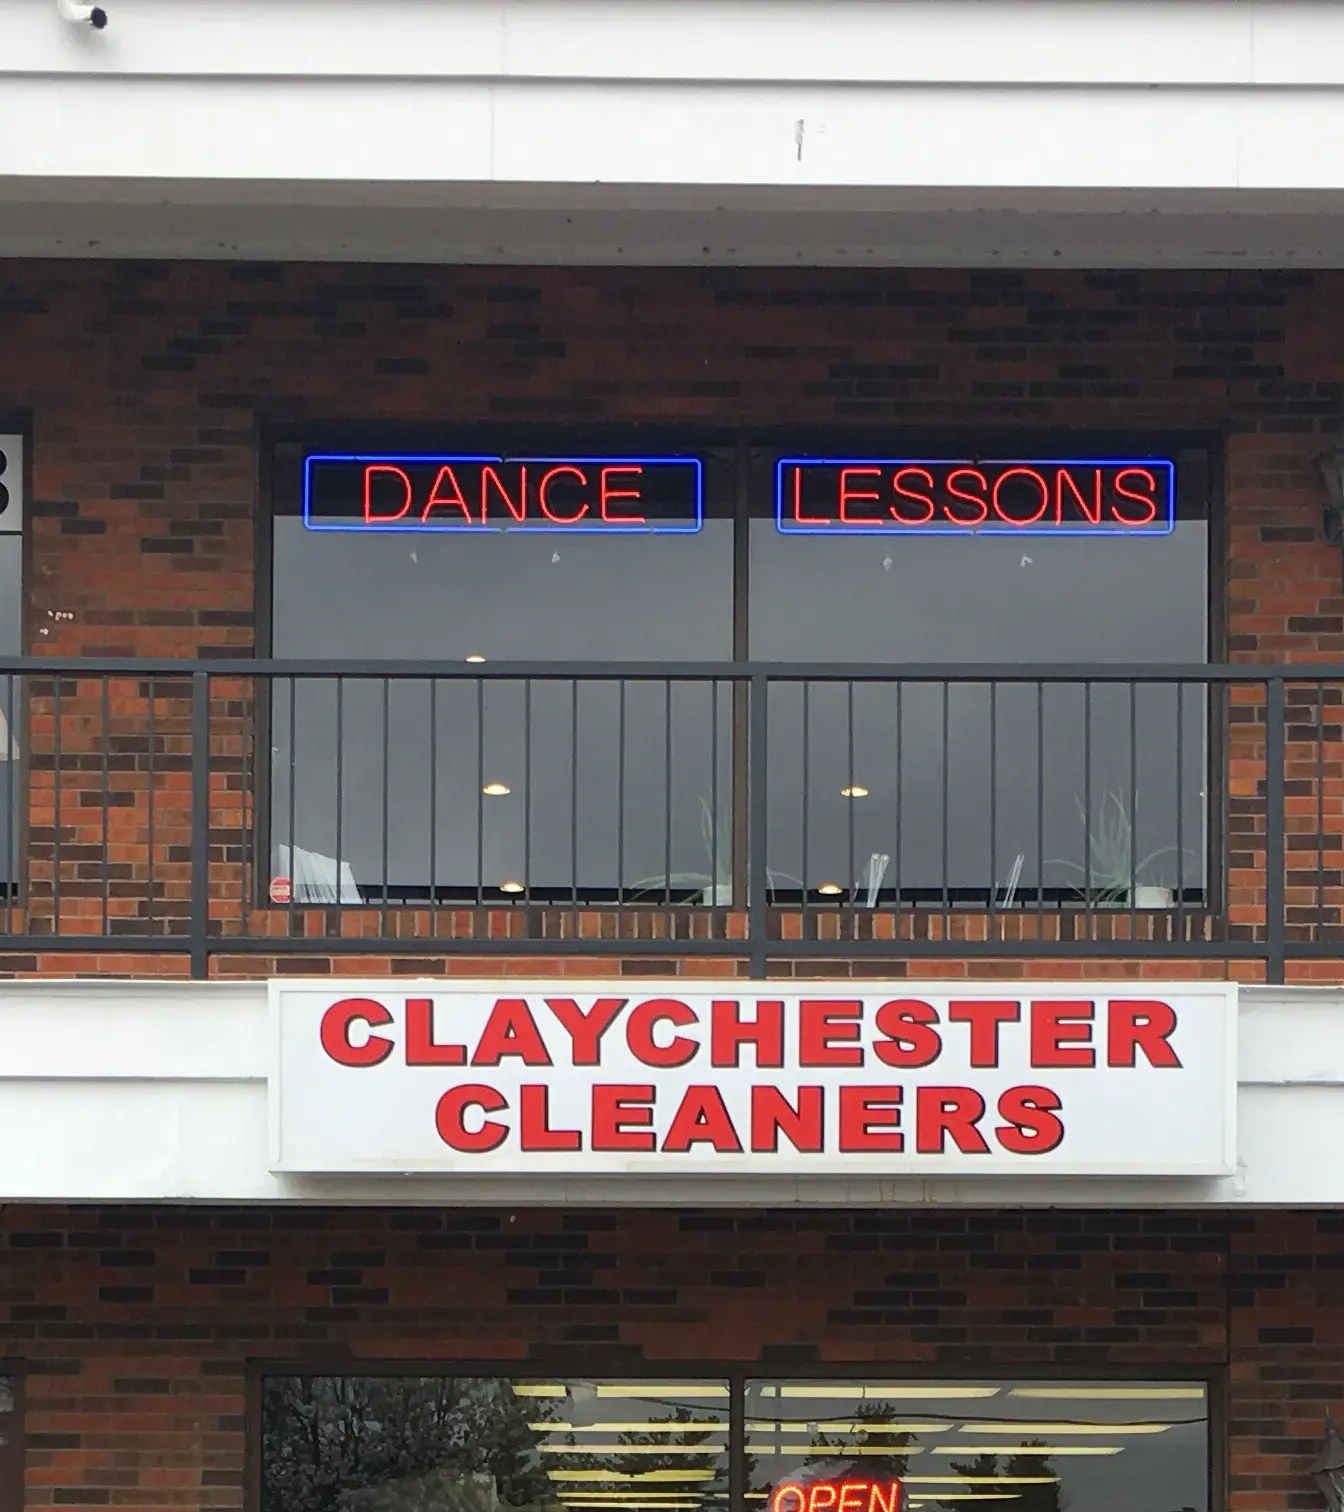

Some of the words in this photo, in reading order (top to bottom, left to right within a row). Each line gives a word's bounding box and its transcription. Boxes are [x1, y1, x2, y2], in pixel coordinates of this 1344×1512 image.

[363, 466, 646, 524] DANCE
[791, 467, 1158, 526] LESSONS
[319, 997, 1182, 1069] CLAYCHESTER
[435, 1083, 1065, 1154] CLEANERS
